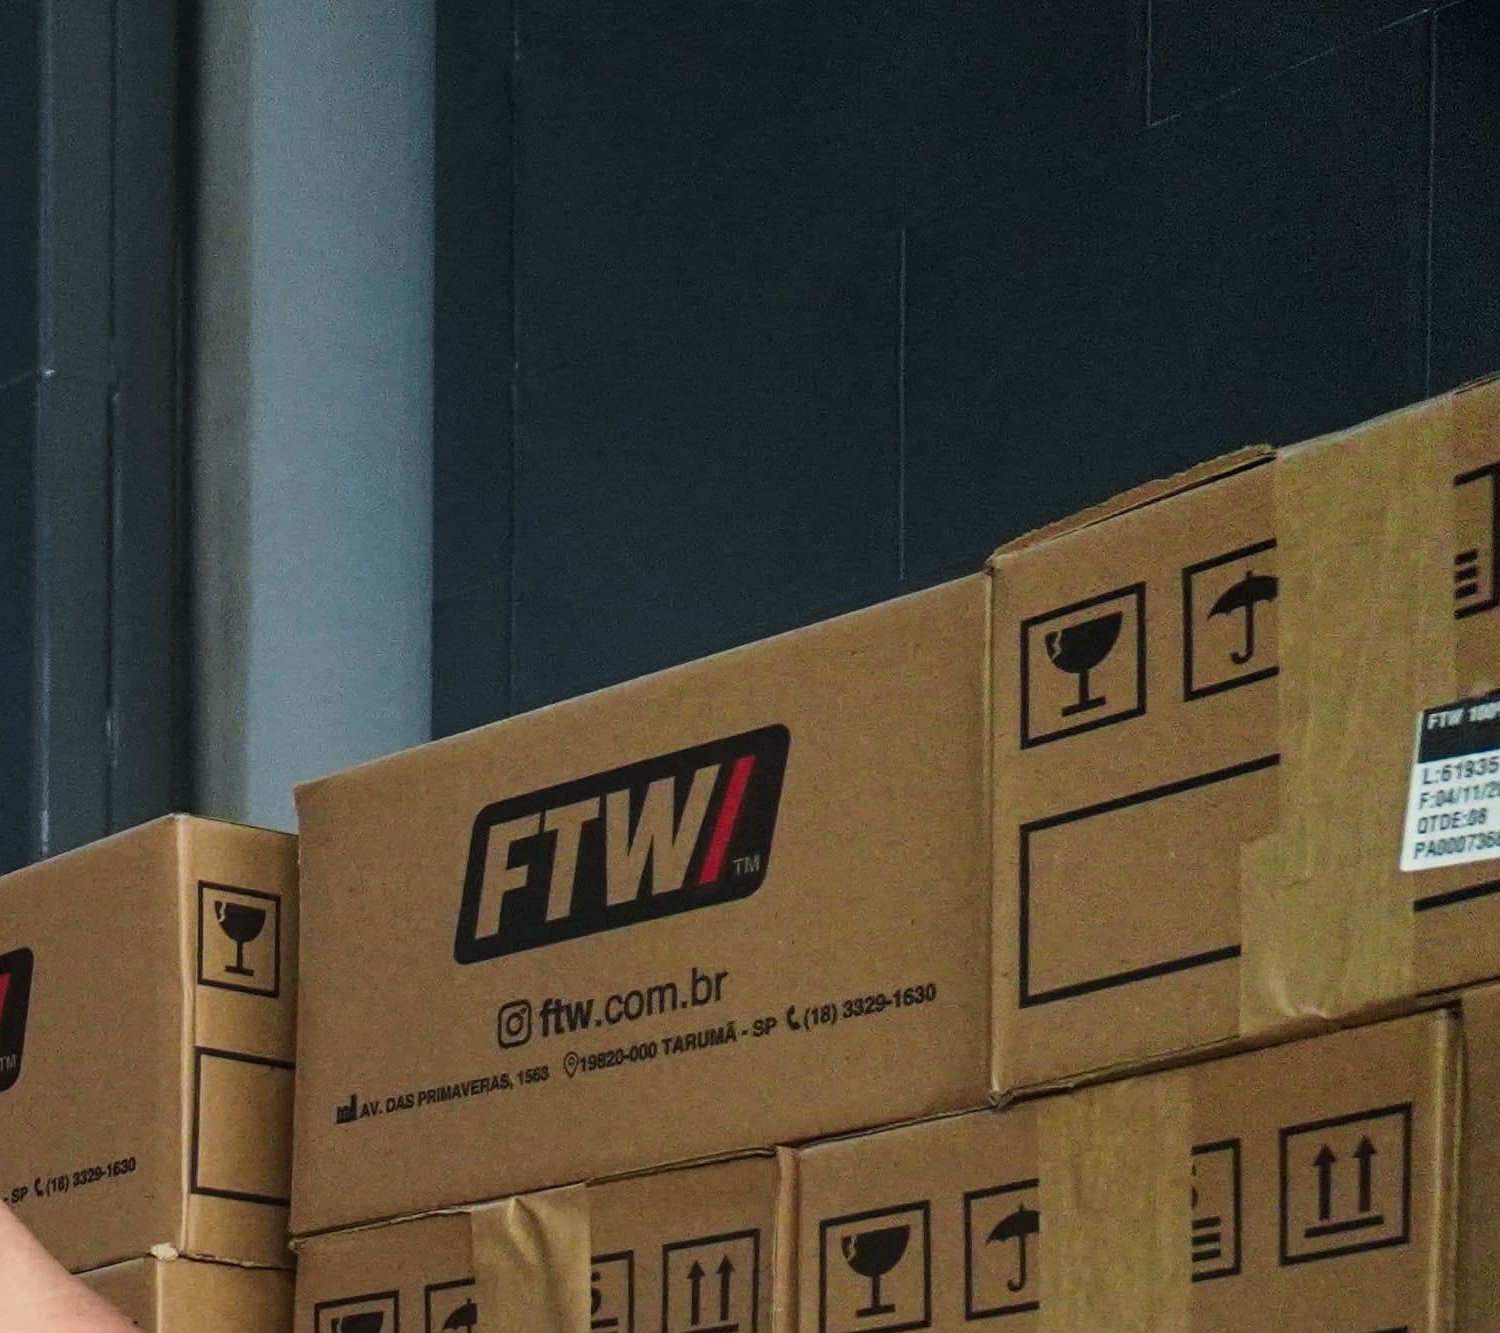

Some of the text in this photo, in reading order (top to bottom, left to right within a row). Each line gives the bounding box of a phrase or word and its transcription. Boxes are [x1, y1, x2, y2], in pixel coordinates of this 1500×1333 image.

[1422, 757, 1499, 784] L:61935
[475, 763, 722, 941] FTW
[539, 967, 728, 1038] ftw.com.br
[803, 983, 936, 1031] (18) 3329-1630
[580, 1016, 776, 1074] 19820-000 TARUMÃ SP
[360, 1065, 550, 1120] AV. DAS PRIMAVERAS, 1563
[12, 1157, 136, 1205] SP (18) 3329-1630
